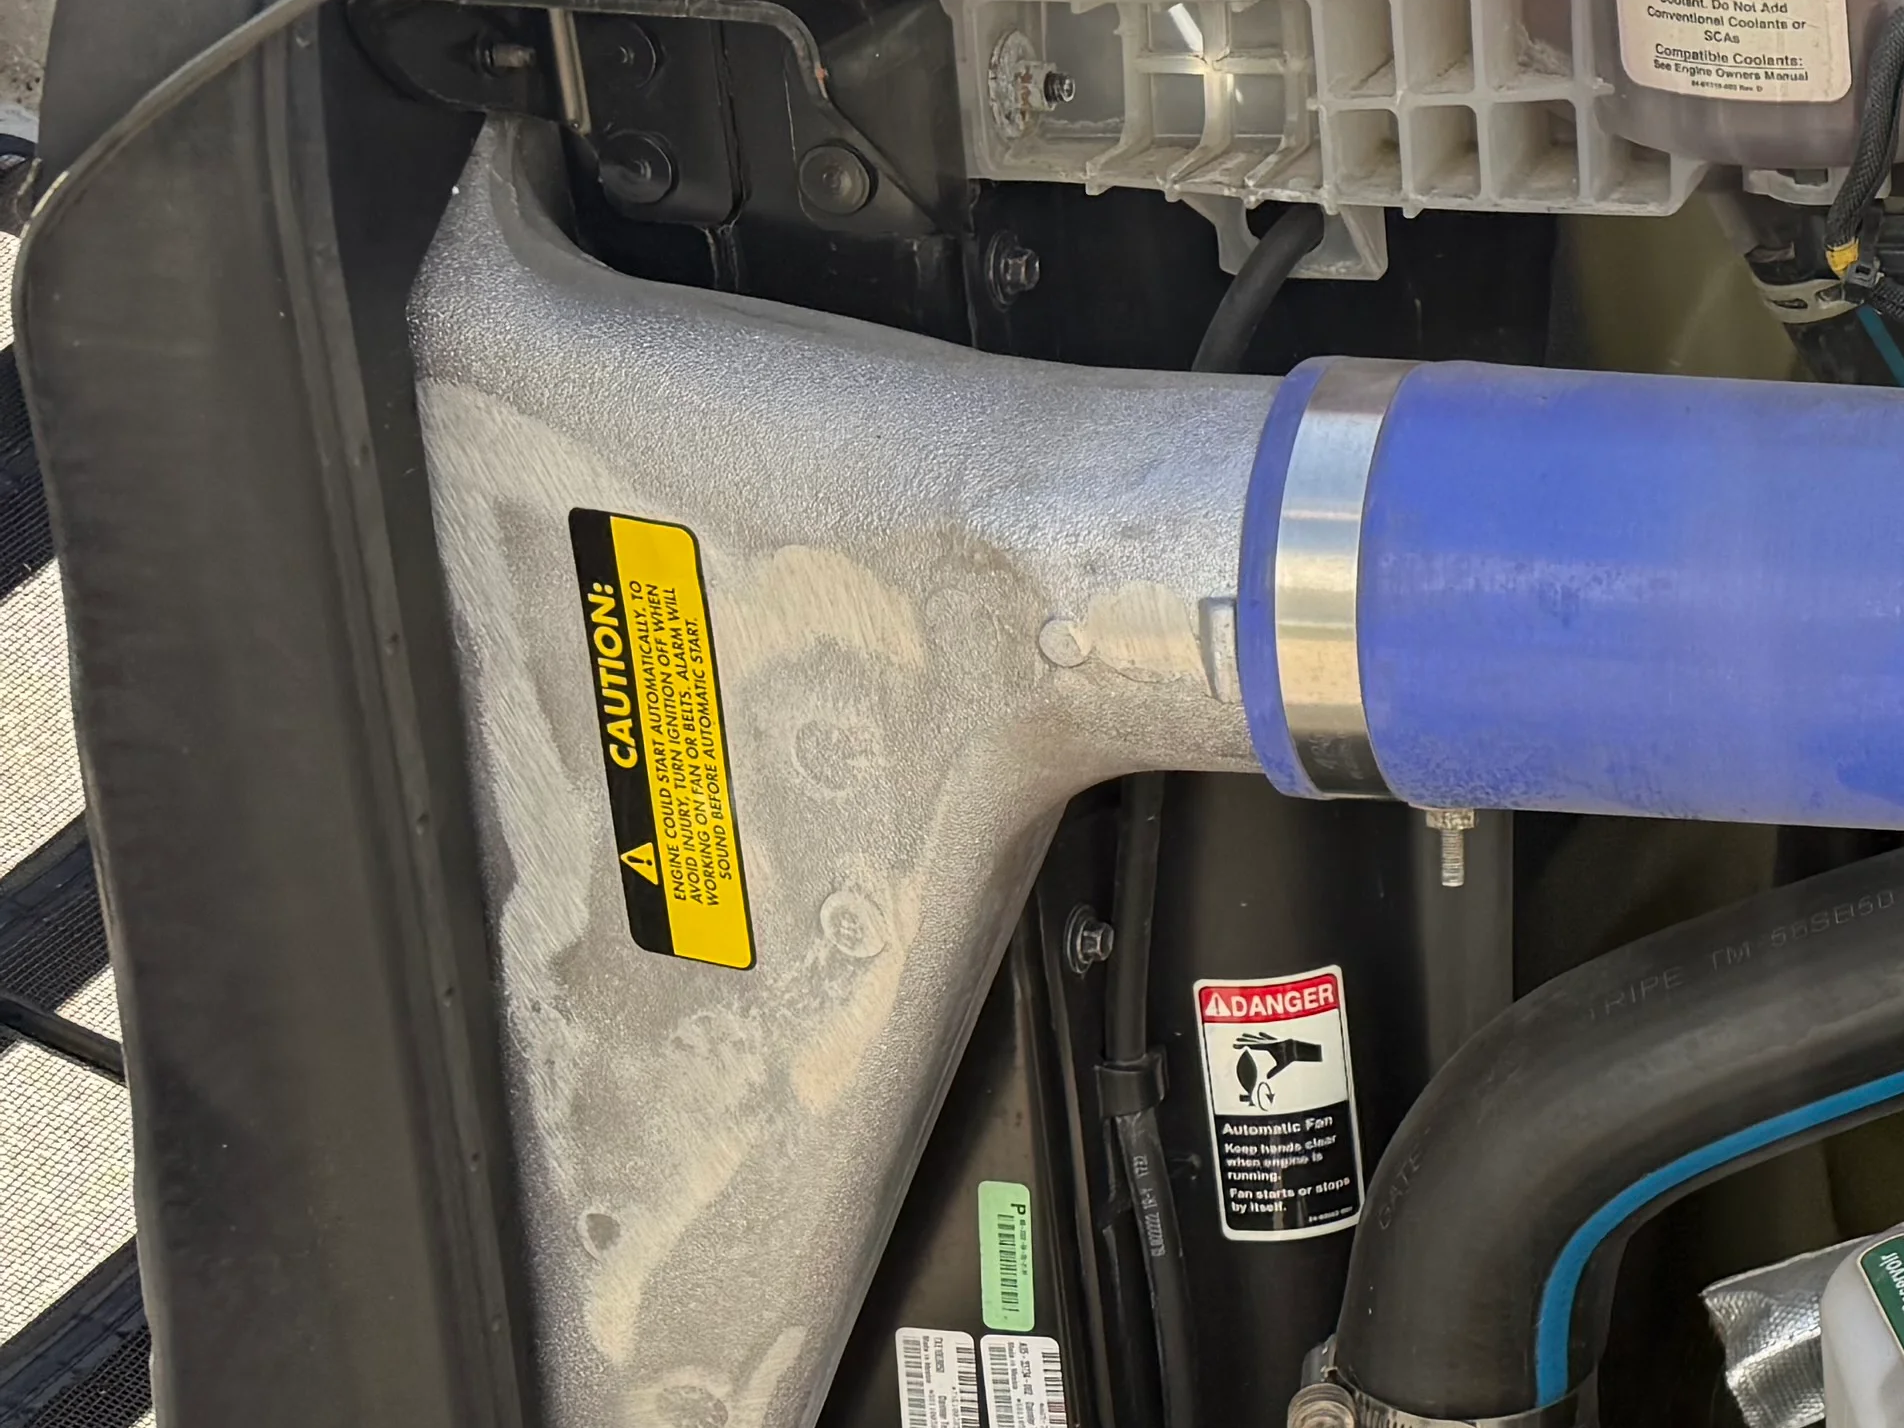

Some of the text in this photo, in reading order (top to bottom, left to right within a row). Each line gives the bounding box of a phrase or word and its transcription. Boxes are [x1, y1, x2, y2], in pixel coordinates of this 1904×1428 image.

[1647, 6, 1806, 30] Conventional Coolants or
[1734, 1, 1756, 13] Not
[1761, 2, 1787, 13] Add
[1704, 30, 1740, 43] SCAs
[1656, 44, 1803, 66] Compatible Coolants:
[1654, 60, 1808, 81] See Engine Owners Manual
[588, 580, 638, 770] CAUTION:
[629, 581, 686, 900] ENGINE COULD START AUTOMATICALLY. TO
[646, 584, 703, 904] AVOID INJURY, TURN IGNITION OFF WHEN
[663, 588, 719, 906] WORKING ON FAN OR BELTS. ALARM WILL
[685, 618, 731, 880] SOUND BEFORE AUTOMATIC START.
[1231, 983, 1334, 1018] DANGER
[1222, 1116, 1333, 1136] Automatic Fan
[1224, 1143, 1257, 1156] Keep
[1260, 1141, 1302, 1155] hands
[1227, 1171, 1282, 1182] running.
[1230, 1177, 1350, 1199] Fan starts or stops
[1010, 1203, 1026, 1215] P
[1232, 1200, 1287, 1214] by itself.
